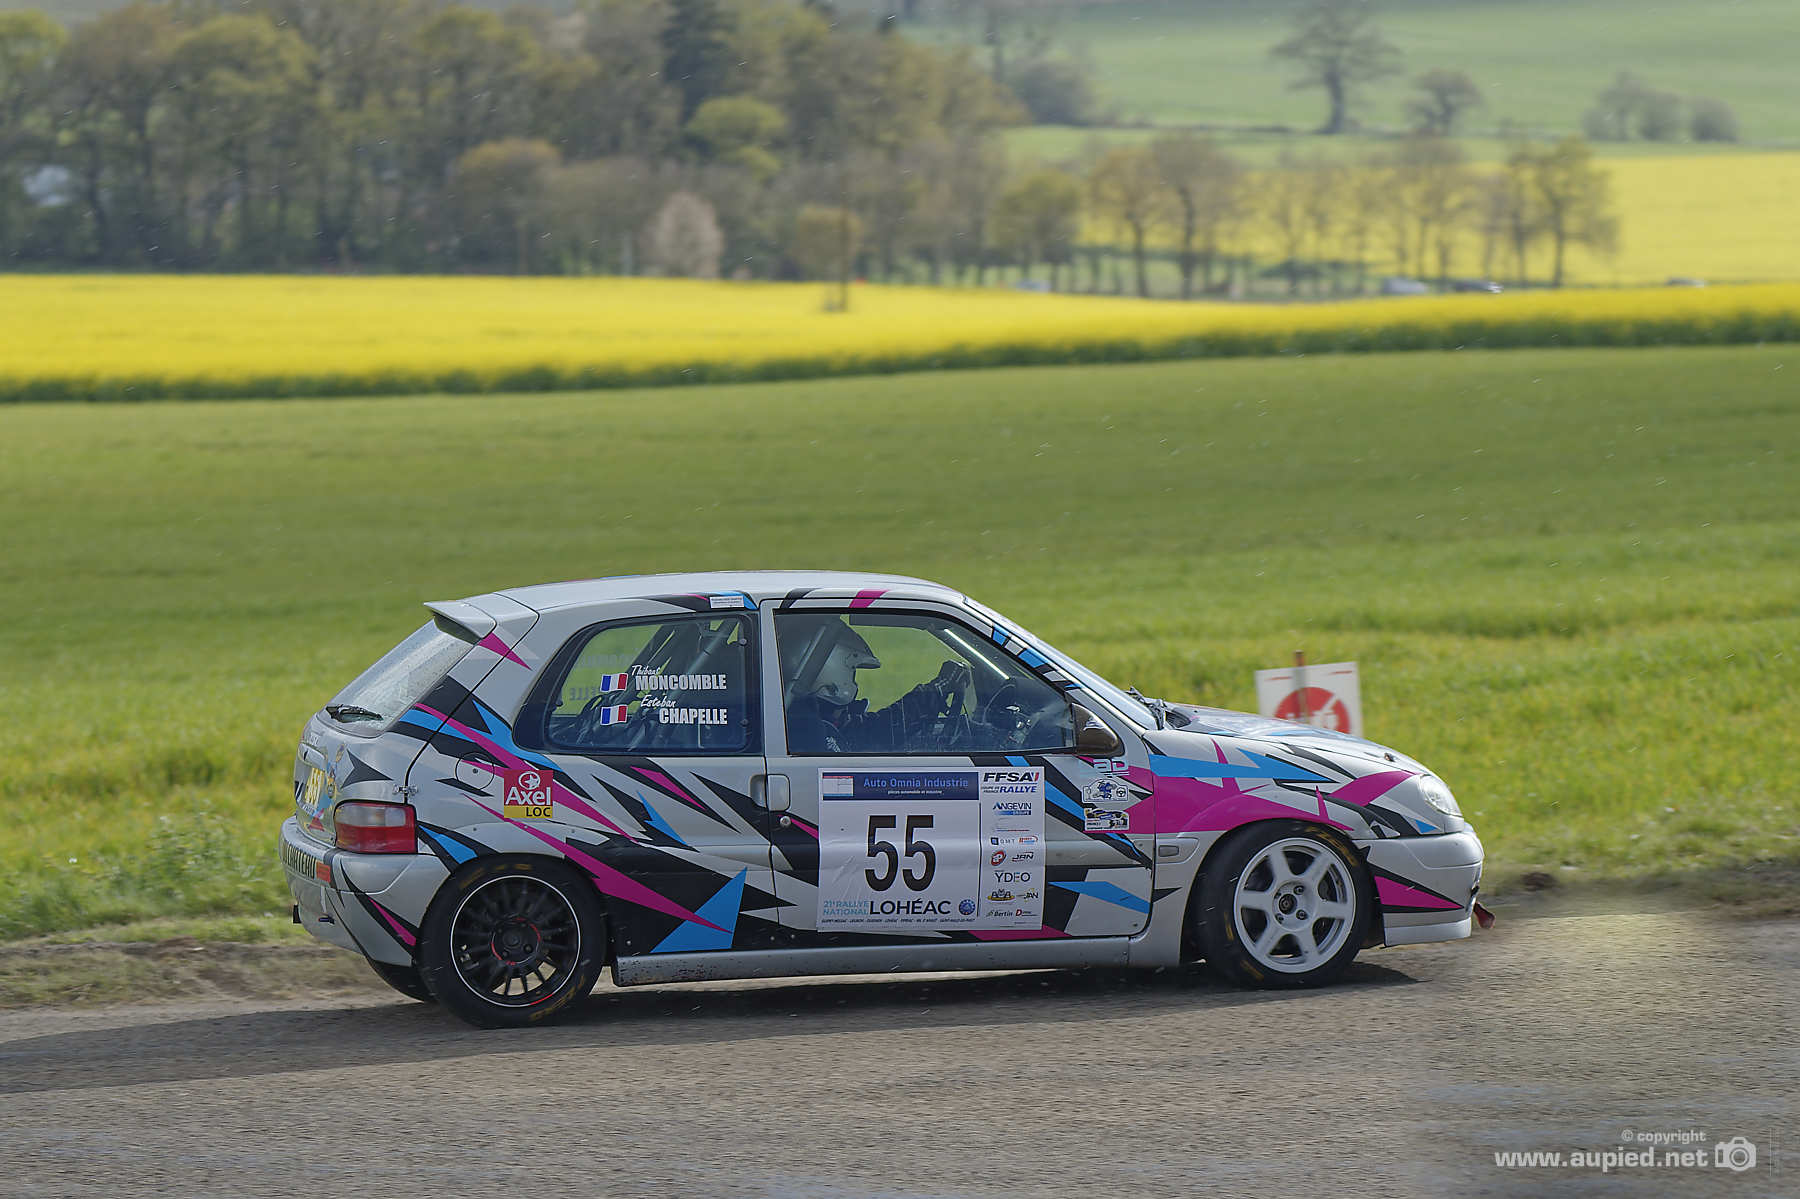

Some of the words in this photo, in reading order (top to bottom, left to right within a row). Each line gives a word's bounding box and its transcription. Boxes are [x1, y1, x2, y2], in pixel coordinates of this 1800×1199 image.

[635, 674, 727, 691] MONCOMBLE
[640, 694, 677, 708] Esteban
[659, 707, 728, 725] CHAPELLE
[863, 778, 887, 788] Auto
[889, 778, 921, 788] Omnia
[924, 778, 969, 788] Industrie
[983, 772, 1034, 782] FFSA
[505, 786, 551, 806] Axel
[999, 785, 1037, 793] RALLYE
[526, 807, 551, 817] LOC
[992, 801, 1032, 810] ANGEVIN
[865, 815, 936, 891] 55
[869, 898, 951, 915] LOHÉAC
